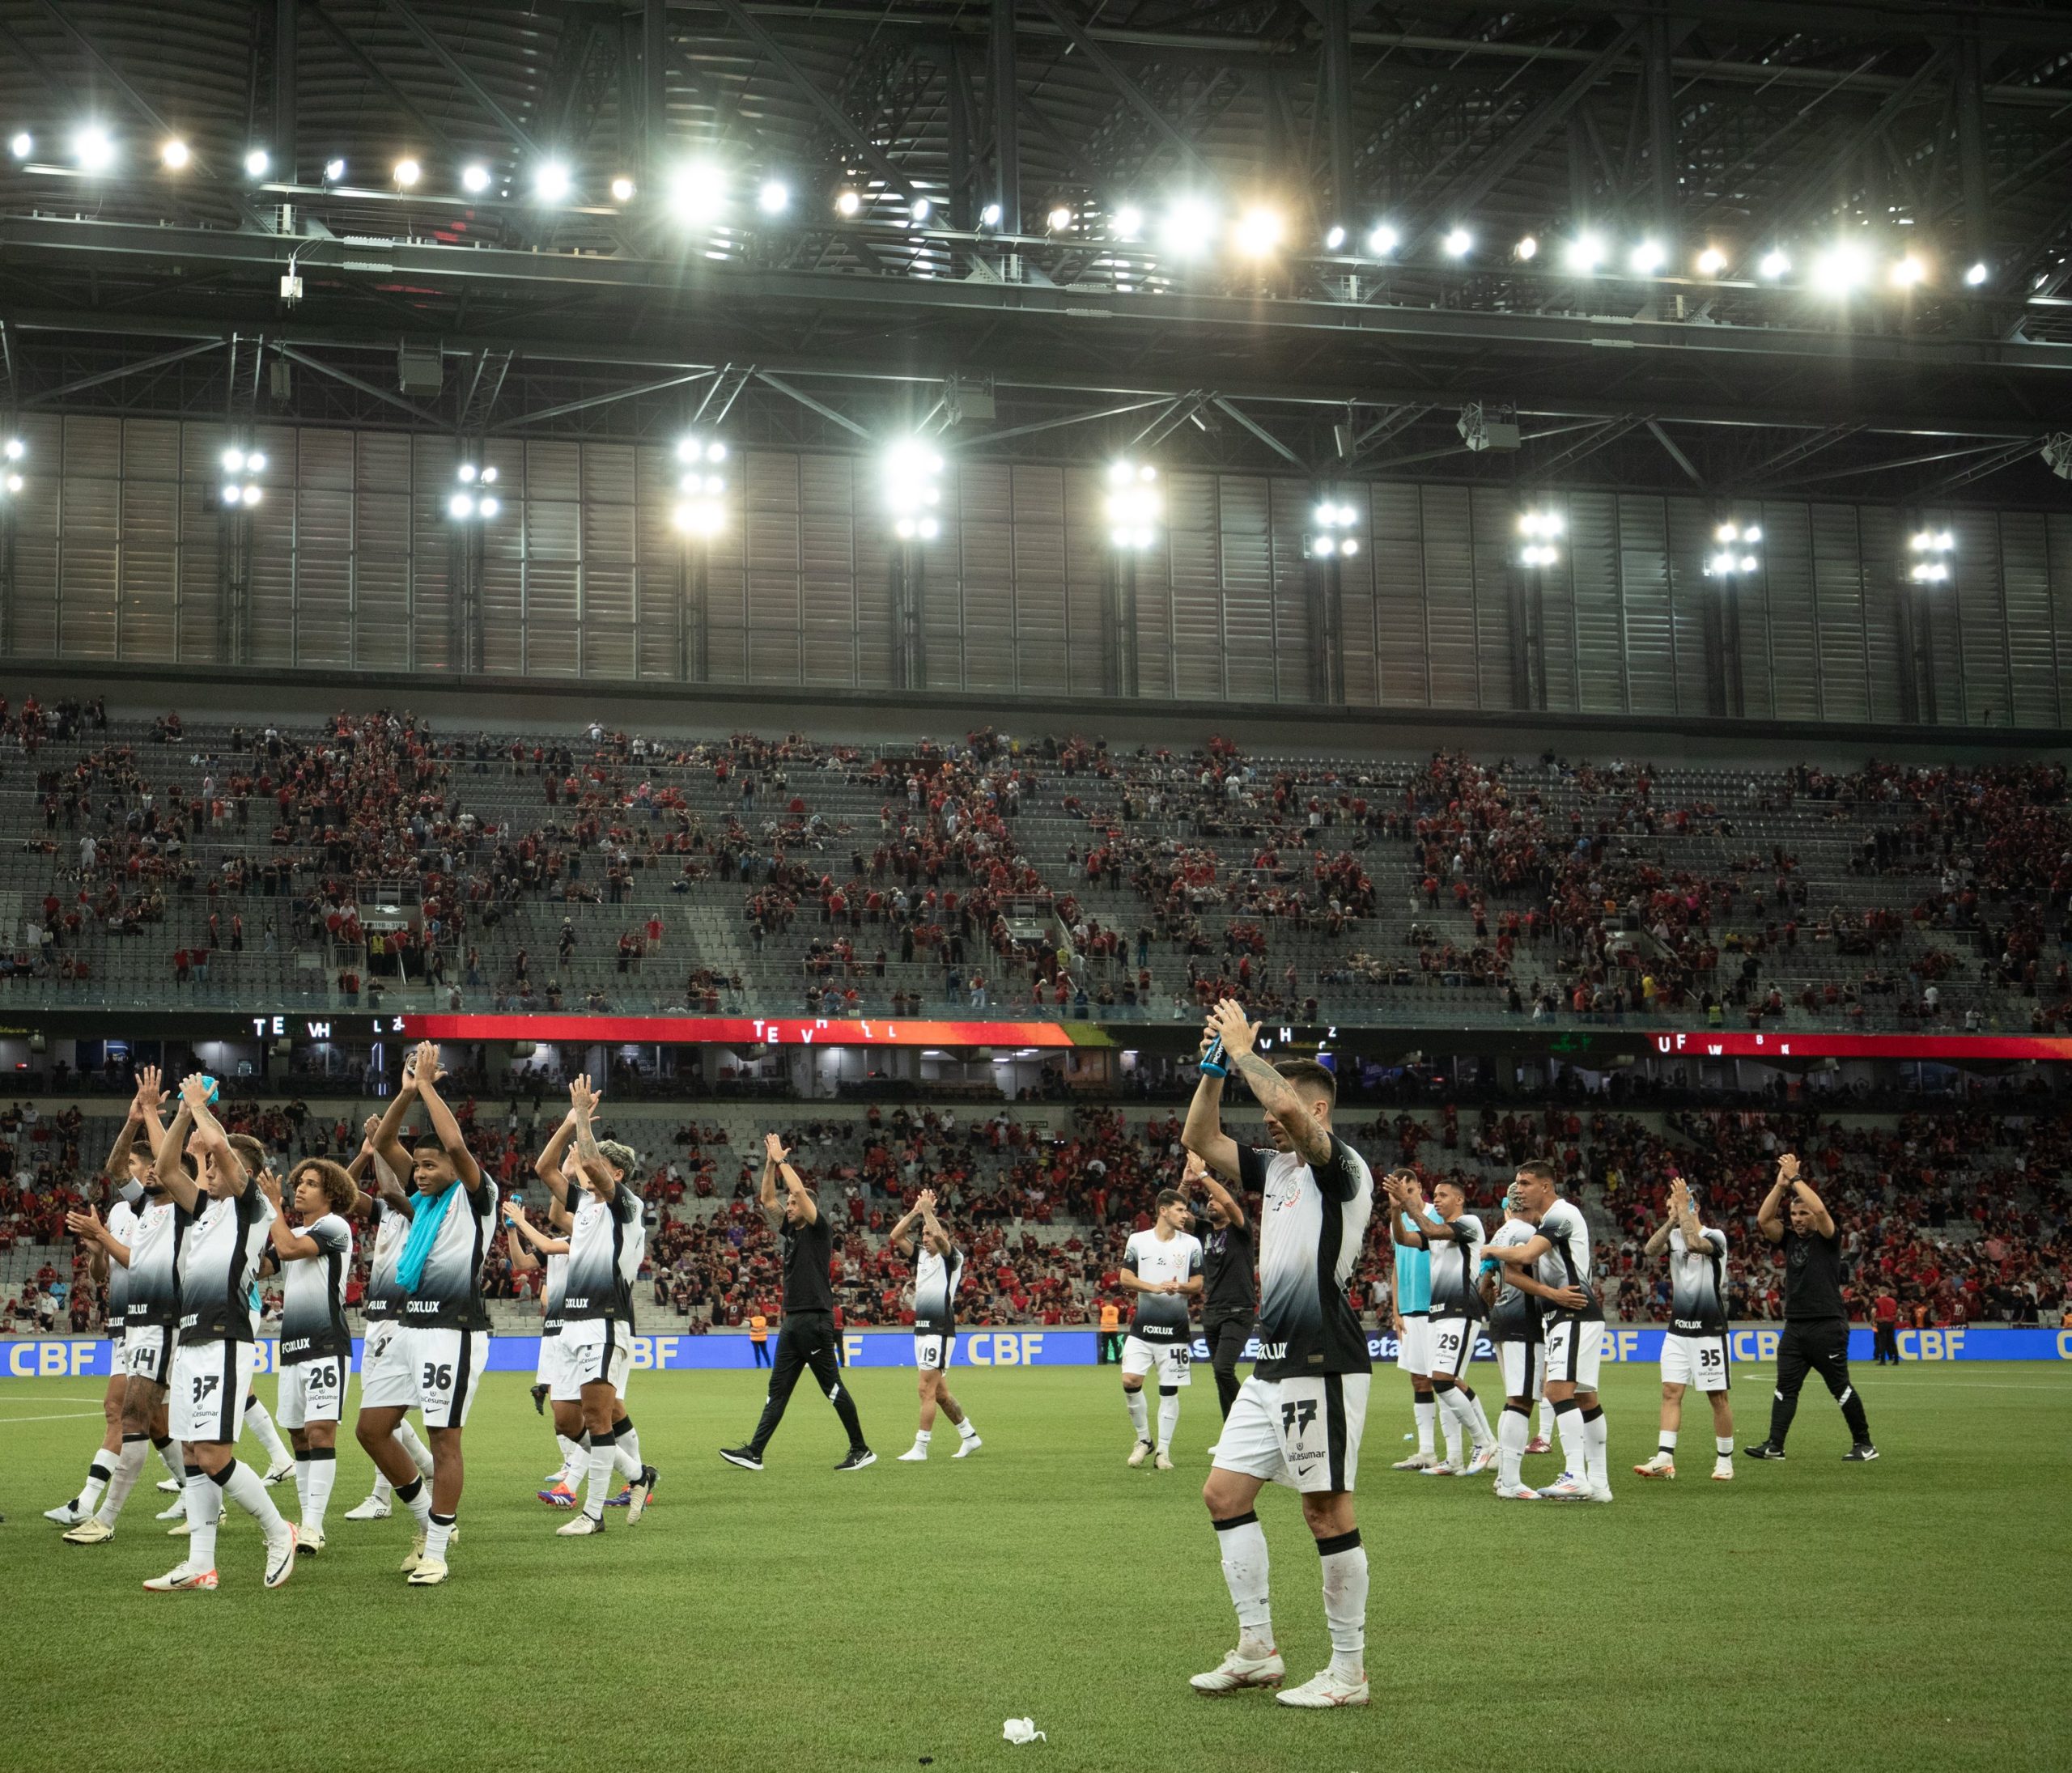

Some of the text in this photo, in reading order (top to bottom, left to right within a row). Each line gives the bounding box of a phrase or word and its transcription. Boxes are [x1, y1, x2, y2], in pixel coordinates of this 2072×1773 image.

[1212, 1041, 1224, 1064] POW
[1143, 1325, 1173, 1336] FOXLUX
[1675, 1319, 1702, 1329] FOXLUX
[282, 1338, 310, 1354] FOXLUX
[967, 1334, 1044, 1365] CBF
[1437, 1333, 1459, 1351] 29
[1475, 1338, 1497, 1357] 2
[1896, 1330, 1965, 1360] CBF
[10, 1342, 96, 1376] CBF
[133, 1347, 156, 1371] 14
[923, 1347, 937, 1363] 19
[1170, 1348, 1189, 1365] 46
[1700, 1348, 1721, 1367] 35
[309, 1365, 338, 1390] 26
[422, 1362, 452, 1390] 36
[193, 1375, 219, 1404] 37
[1281, 1398, 1318, 1440] 77
